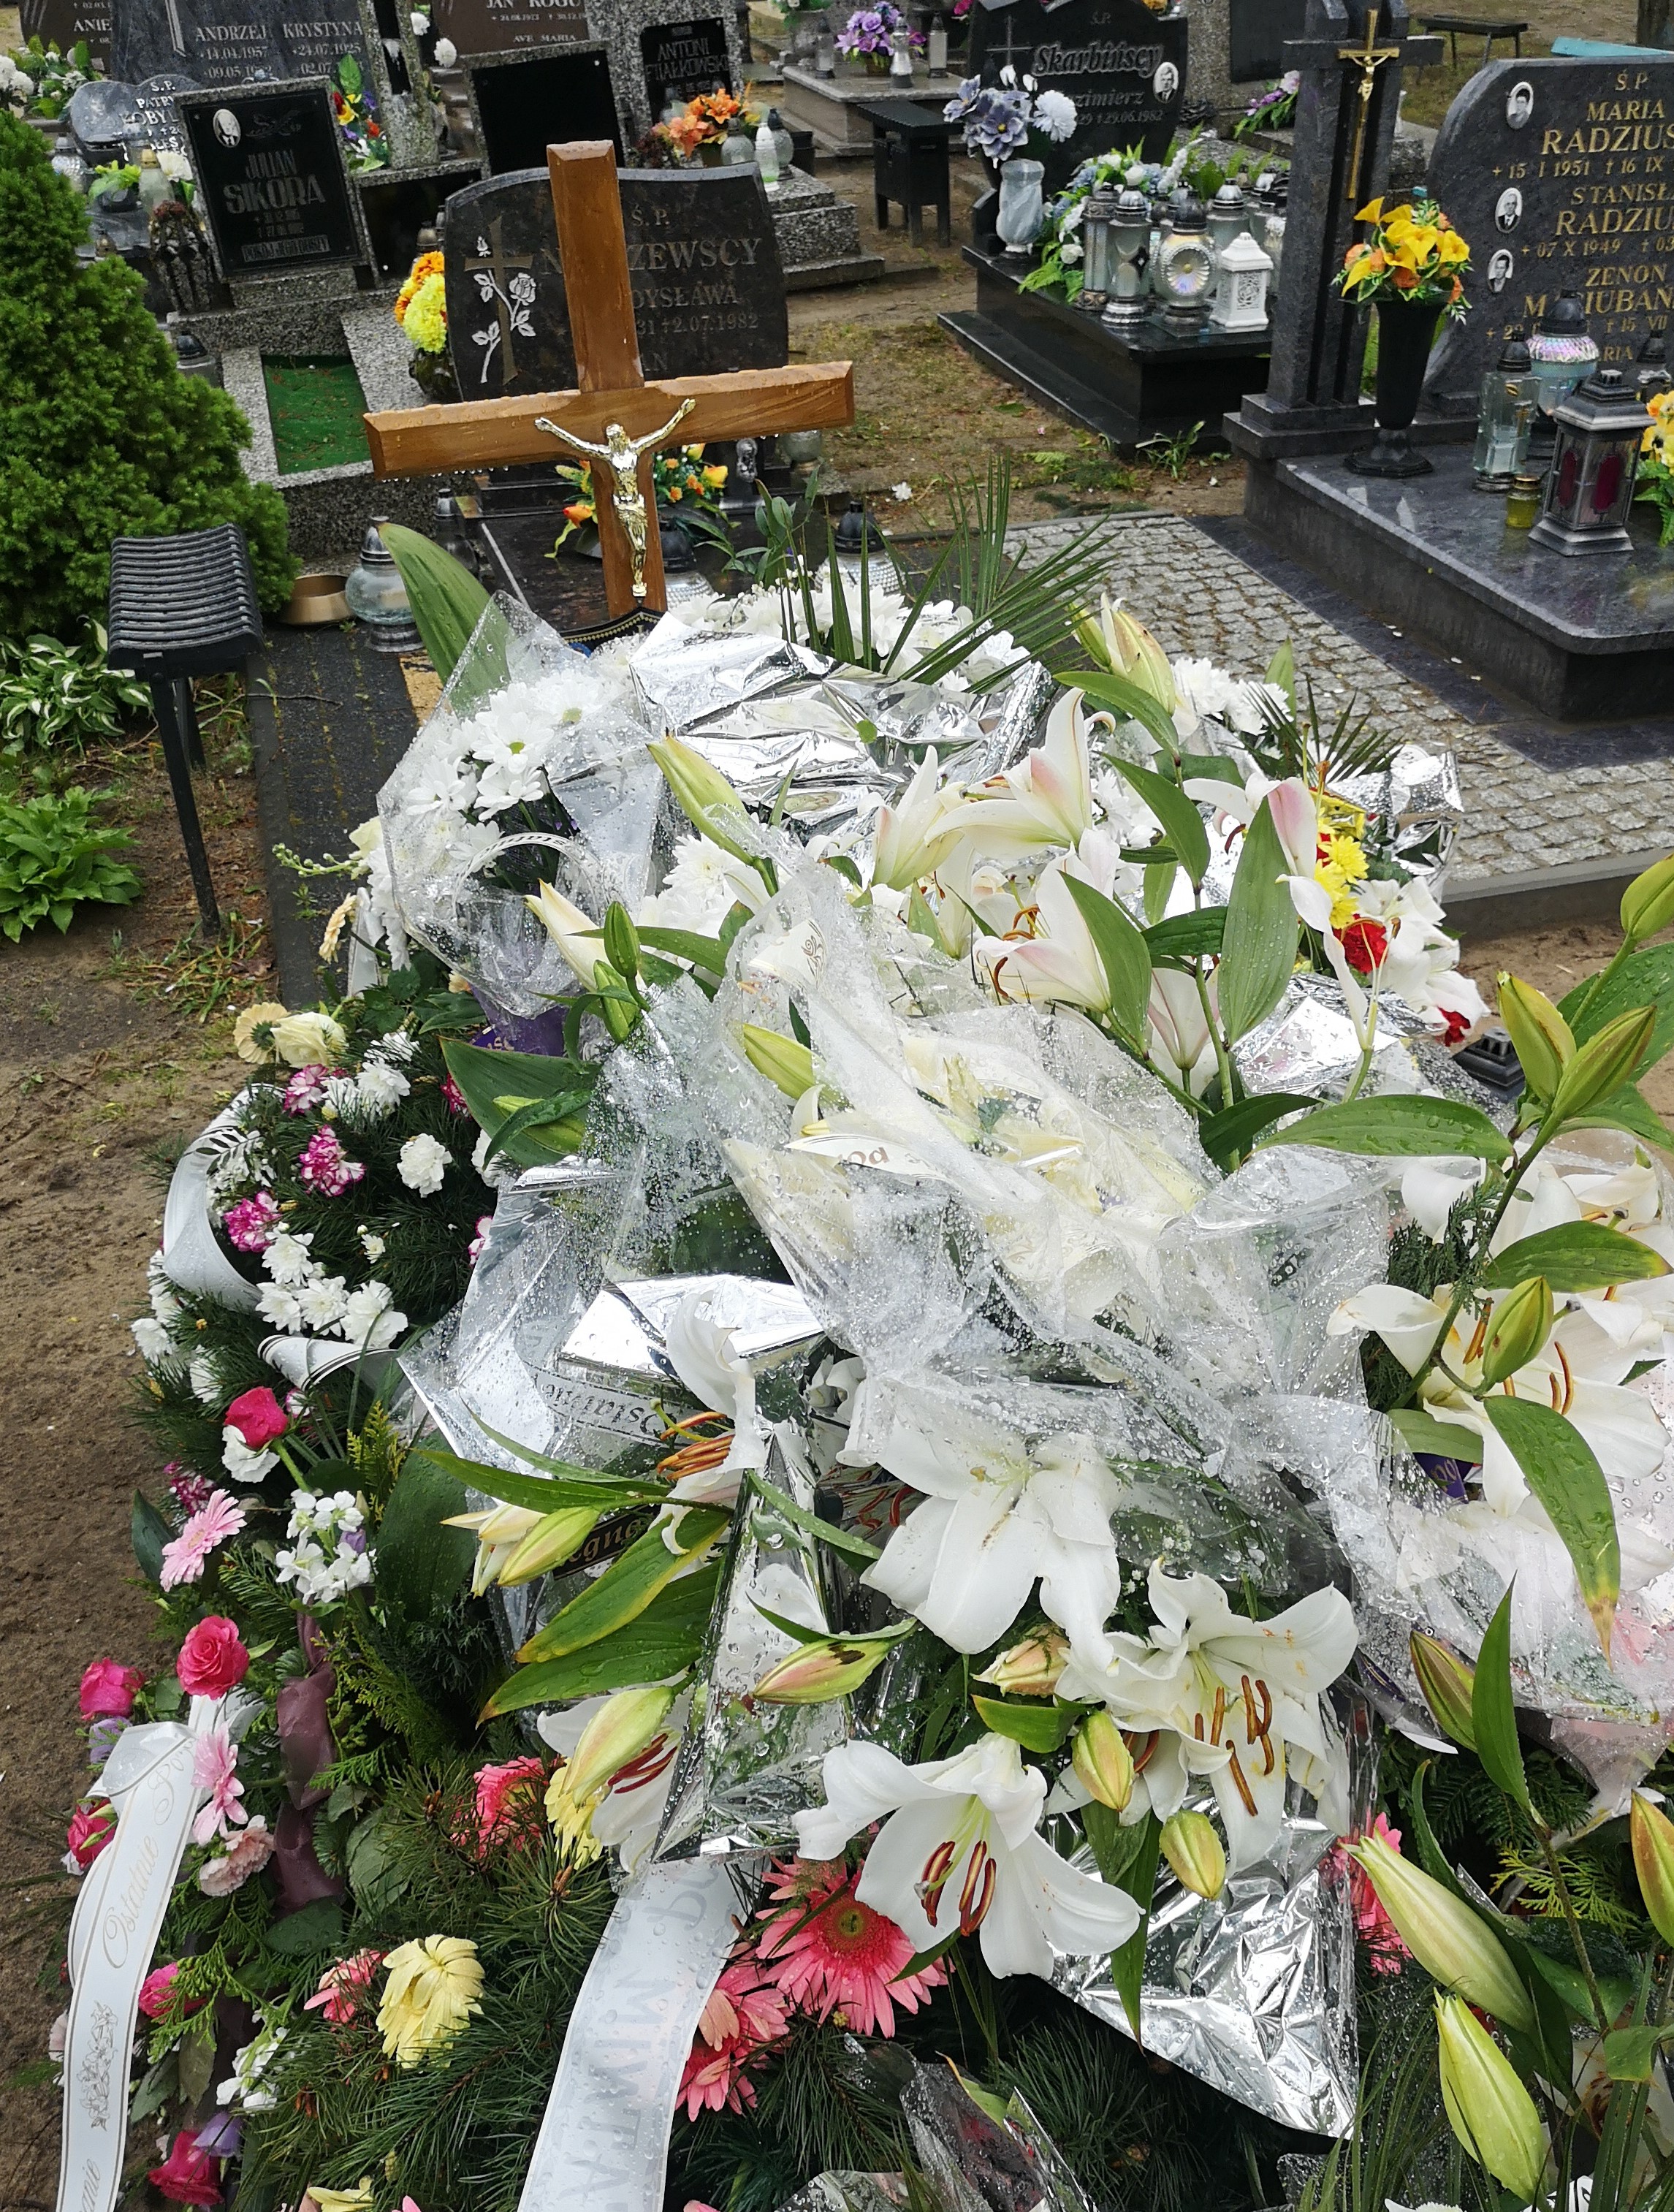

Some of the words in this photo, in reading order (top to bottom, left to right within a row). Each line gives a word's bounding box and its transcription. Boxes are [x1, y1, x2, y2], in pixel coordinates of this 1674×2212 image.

[196, 25, 267, 42] ANDRZEJ
[283, 21, 364, 38] KRYSTYNA
[658, 37, 709, 61] ANTONI
[1586, 99, 1666, 122] MARIA
[245, 150, 297, 180] JULIAN
[1509, 161, 1529, 179] 15
[1553, 159, 1591, 178] 1951
[1620, 156, 1637, 174] 16
[1645, 155, 1665, 173] IX
[223, 174, 327, 213] SIKORA
[1571, 183, 1674, 205] STANISŁ
[1555, 205, 1674, 236] RADZIU
[1584, 263, 1668, 287] ZENON
